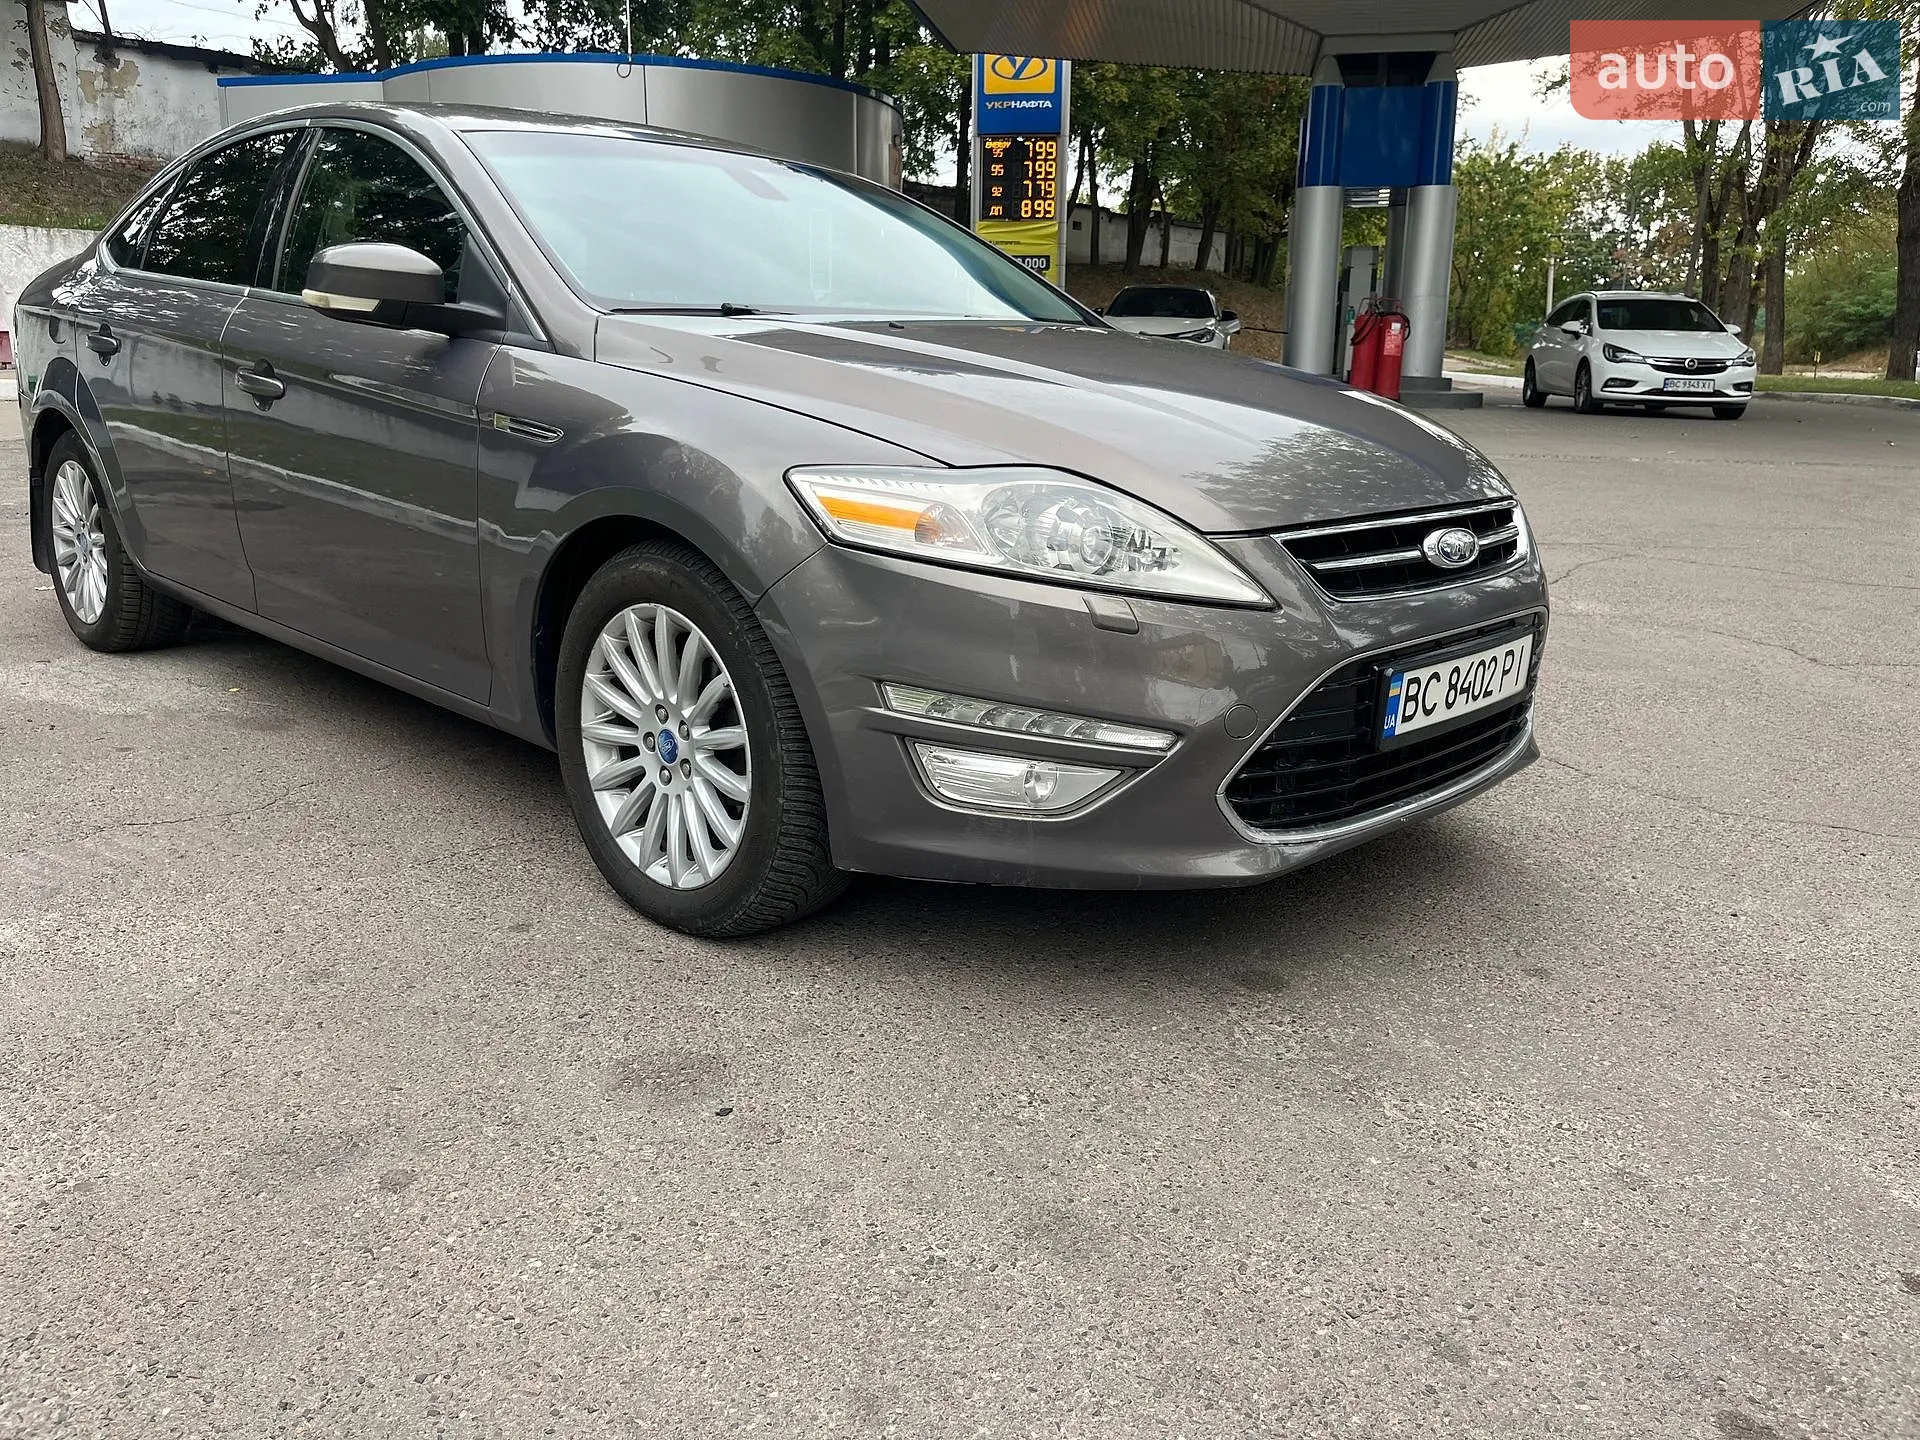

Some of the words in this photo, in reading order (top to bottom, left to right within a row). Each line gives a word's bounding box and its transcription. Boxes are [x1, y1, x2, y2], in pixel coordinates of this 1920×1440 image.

[985, 100, 1053, 109] УКРНАФТА
[1024, 141, 1057, 160] 799
[991, 164, 1004, 176] 95
[1023, 161, 1056, 179] 799
[991, 186, 1003, 197] 92
[1023, 180, 1055, 199] 779
[1021, 199, 1055, 218] 899
[1401, 671, 1441, 724] BC
[1445, 656, 1498, 710] 8402
[1499, 645, 1525, 693] PI
[1384, 714, 1395, 729] UA
